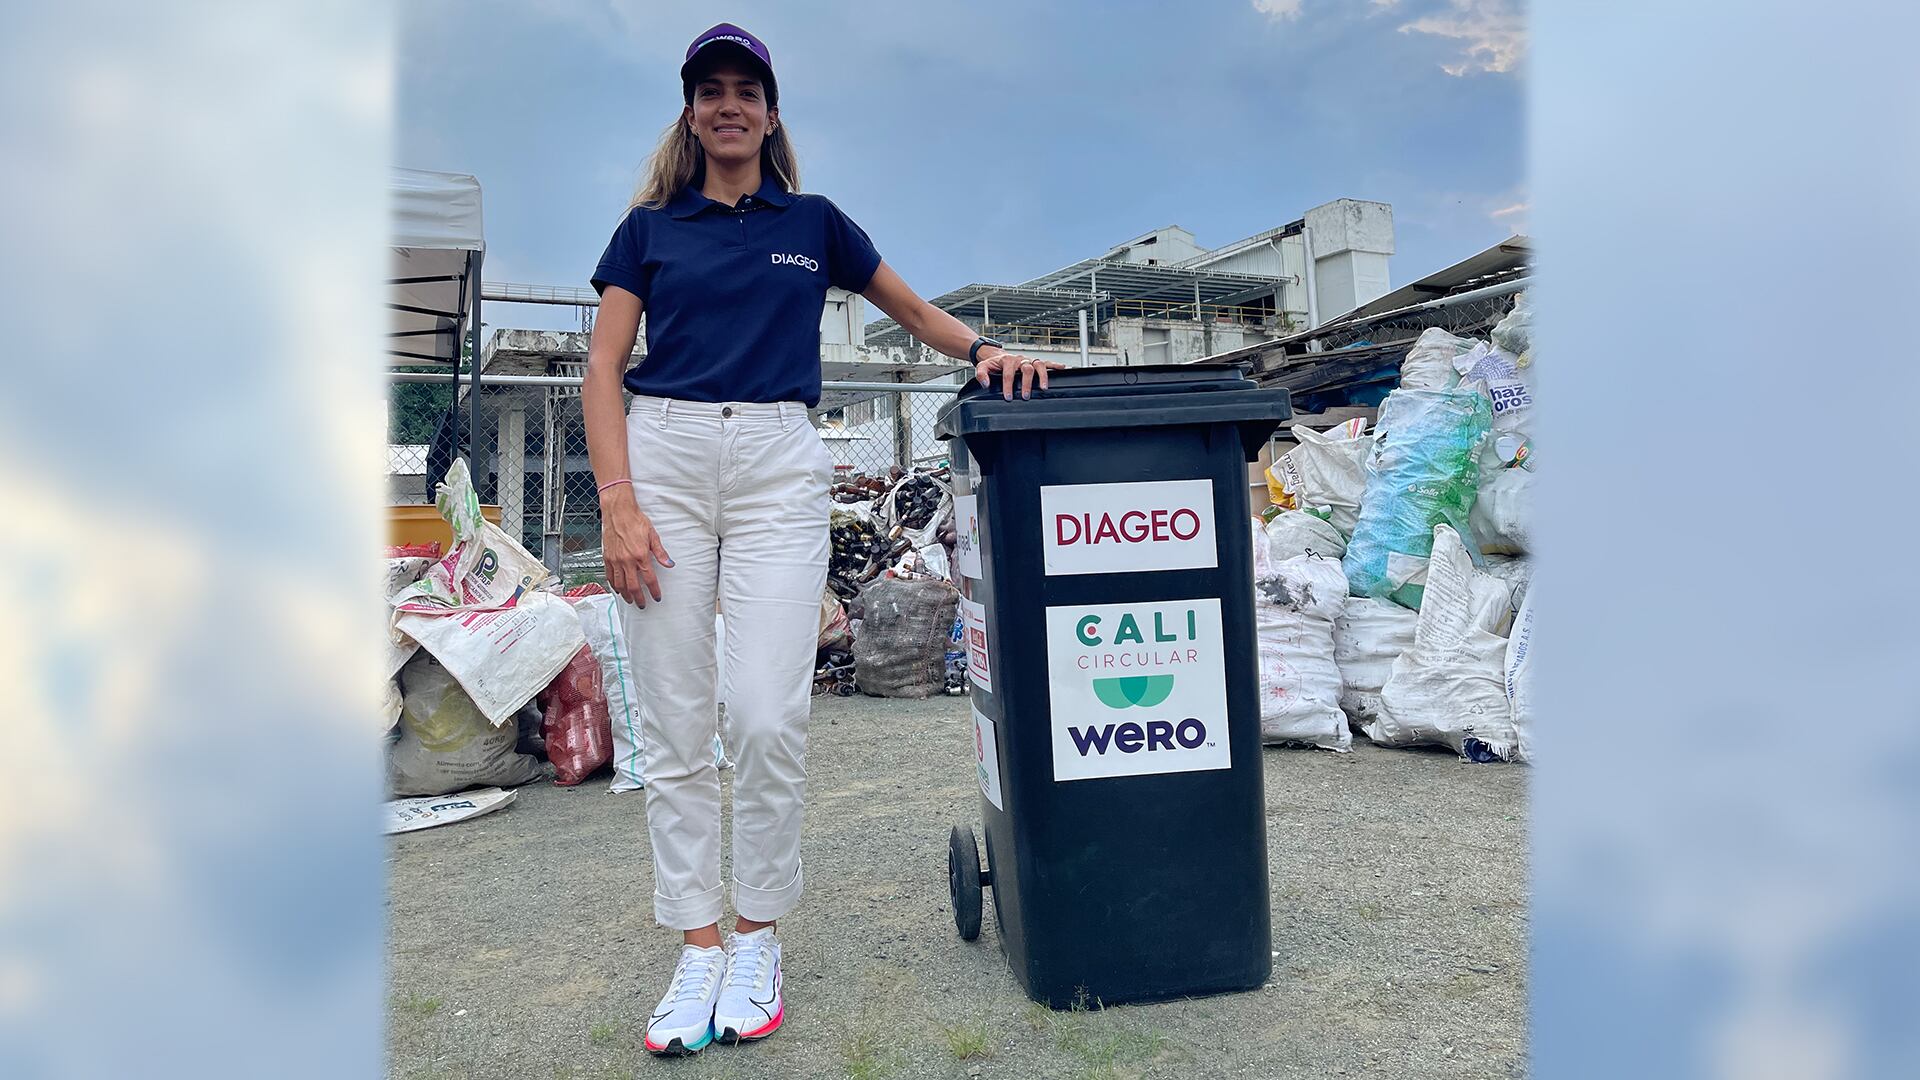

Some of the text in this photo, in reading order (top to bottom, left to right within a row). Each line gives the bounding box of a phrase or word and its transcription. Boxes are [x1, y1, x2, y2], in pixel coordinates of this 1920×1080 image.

[771, 253, 819, 271] DIAGEO
[1055, 508, 1201, 546] DIAGEO
[1075, 609, 1197, 647] CALI
[1077, 648, 1198, 670] CIRCULAR
